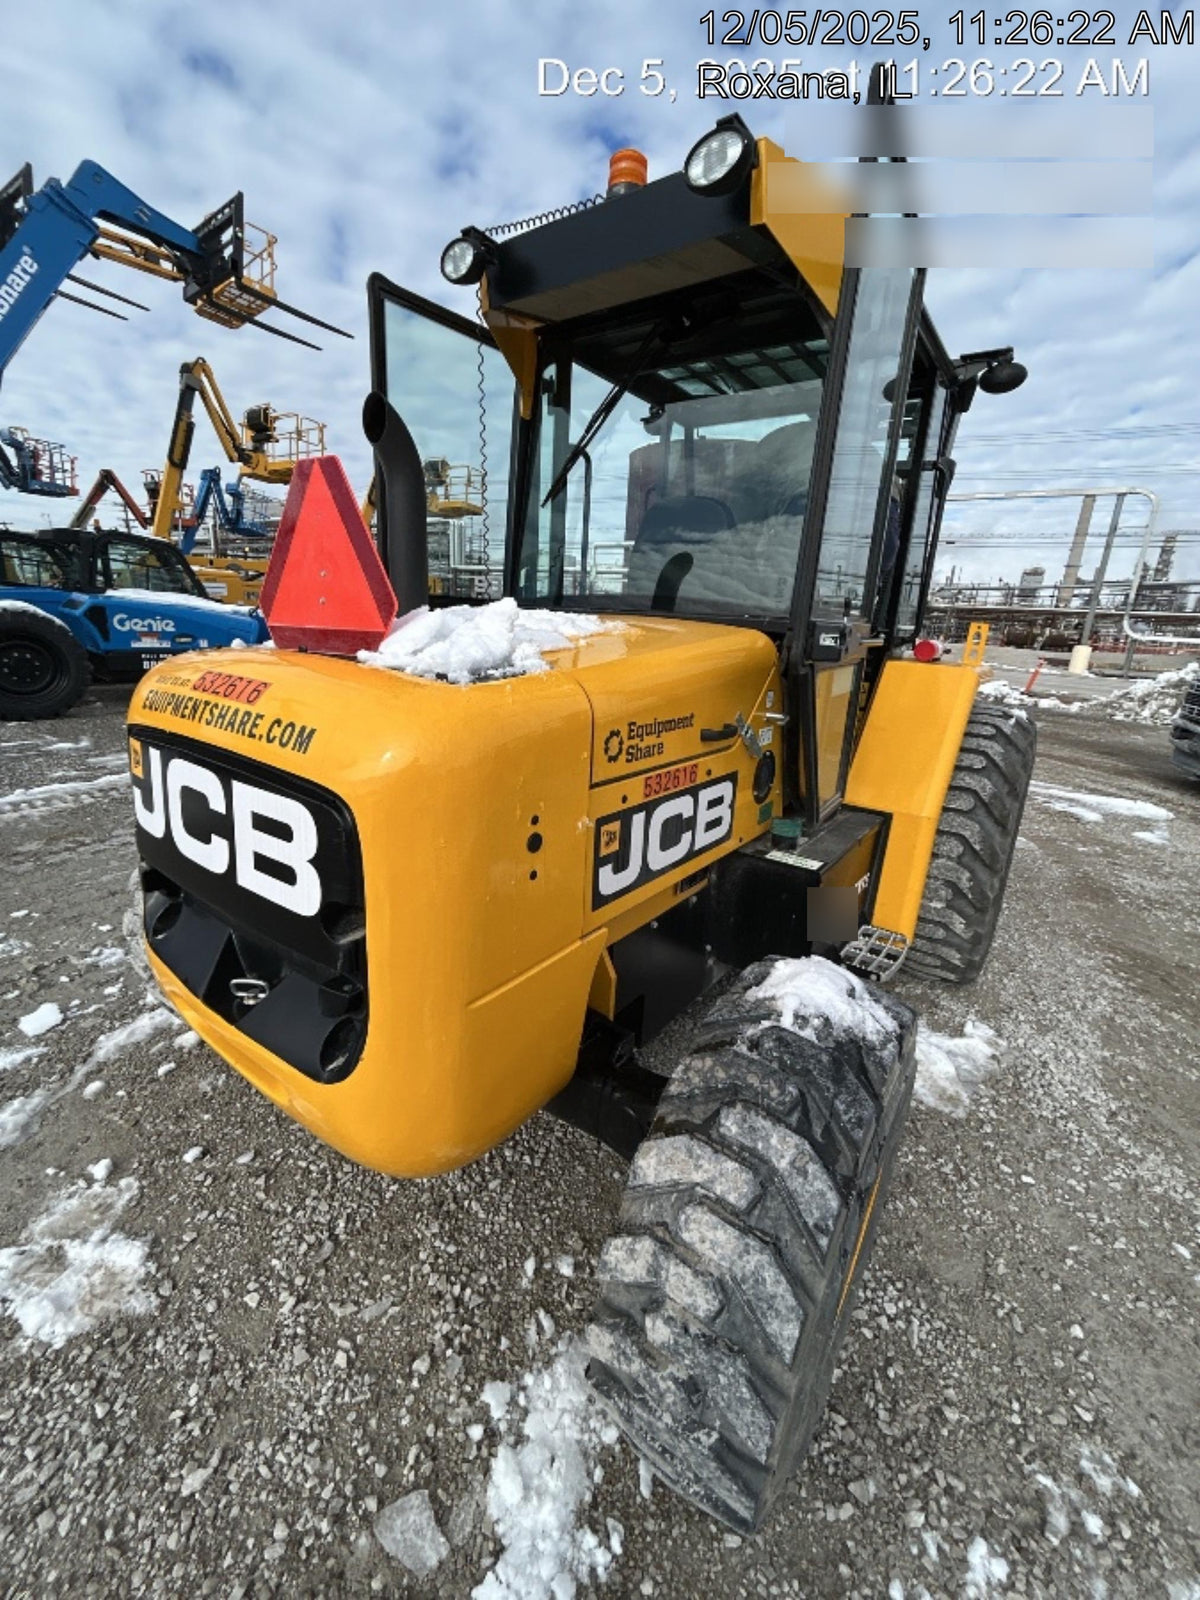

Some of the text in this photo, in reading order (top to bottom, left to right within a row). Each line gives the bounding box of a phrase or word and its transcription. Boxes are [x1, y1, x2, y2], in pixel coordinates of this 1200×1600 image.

[113, 613, 176, 632] Genie
[193, 670, 268, 704] 532616
[142, 689, 317, 755] EQUIPMENTSHARE.COM
[627, 712, 694, 742] Equipment
[625, 741, 664, 763] Share
[644, 763, 698, 798] 532616
[132, 746, 322, 917] JCB
[599, 780, 734, 895] JCB
